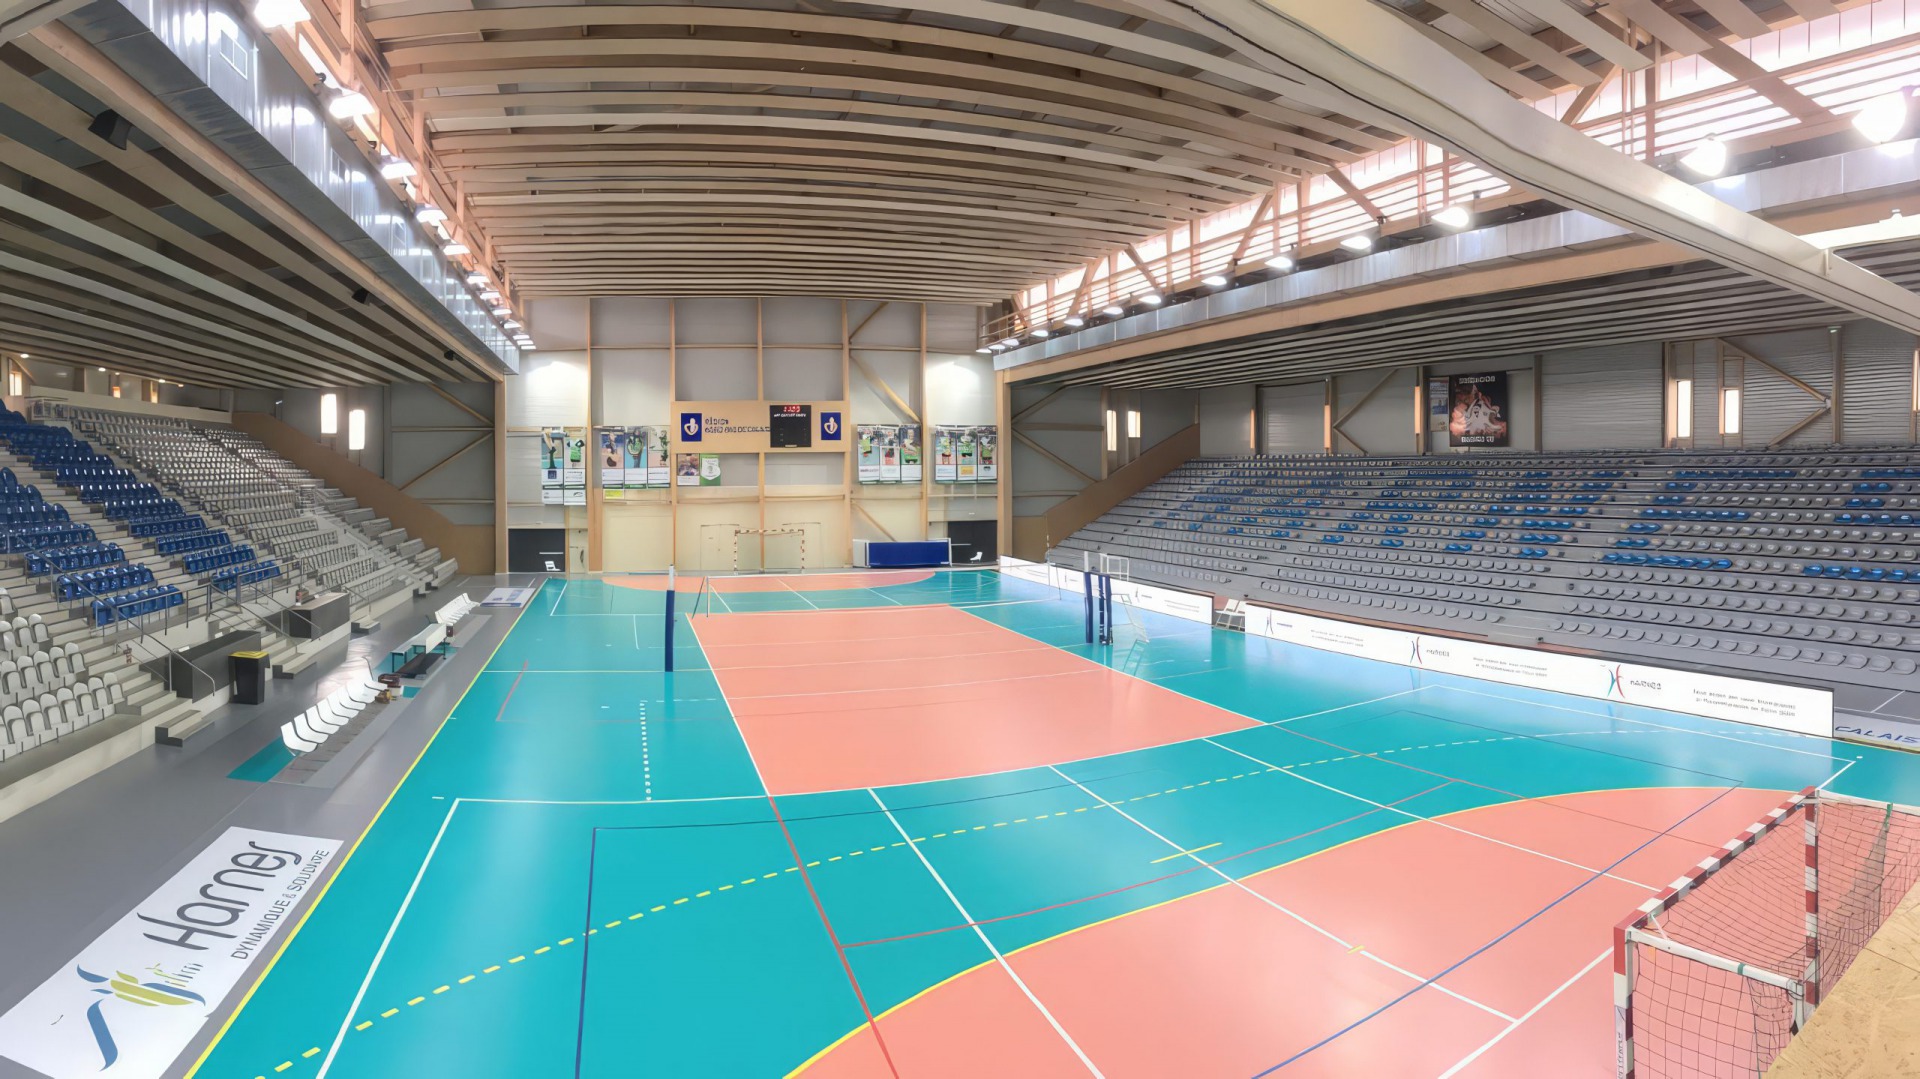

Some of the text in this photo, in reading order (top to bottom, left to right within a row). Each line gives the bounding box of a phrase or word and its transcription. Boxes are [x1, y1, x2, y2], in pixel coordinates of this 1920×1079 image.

[1834, 726, 1920, 744] CALAIS
[136, 840, 303, 951] Harnes
[230, 899, 291, 960] DYNAMIQUE
